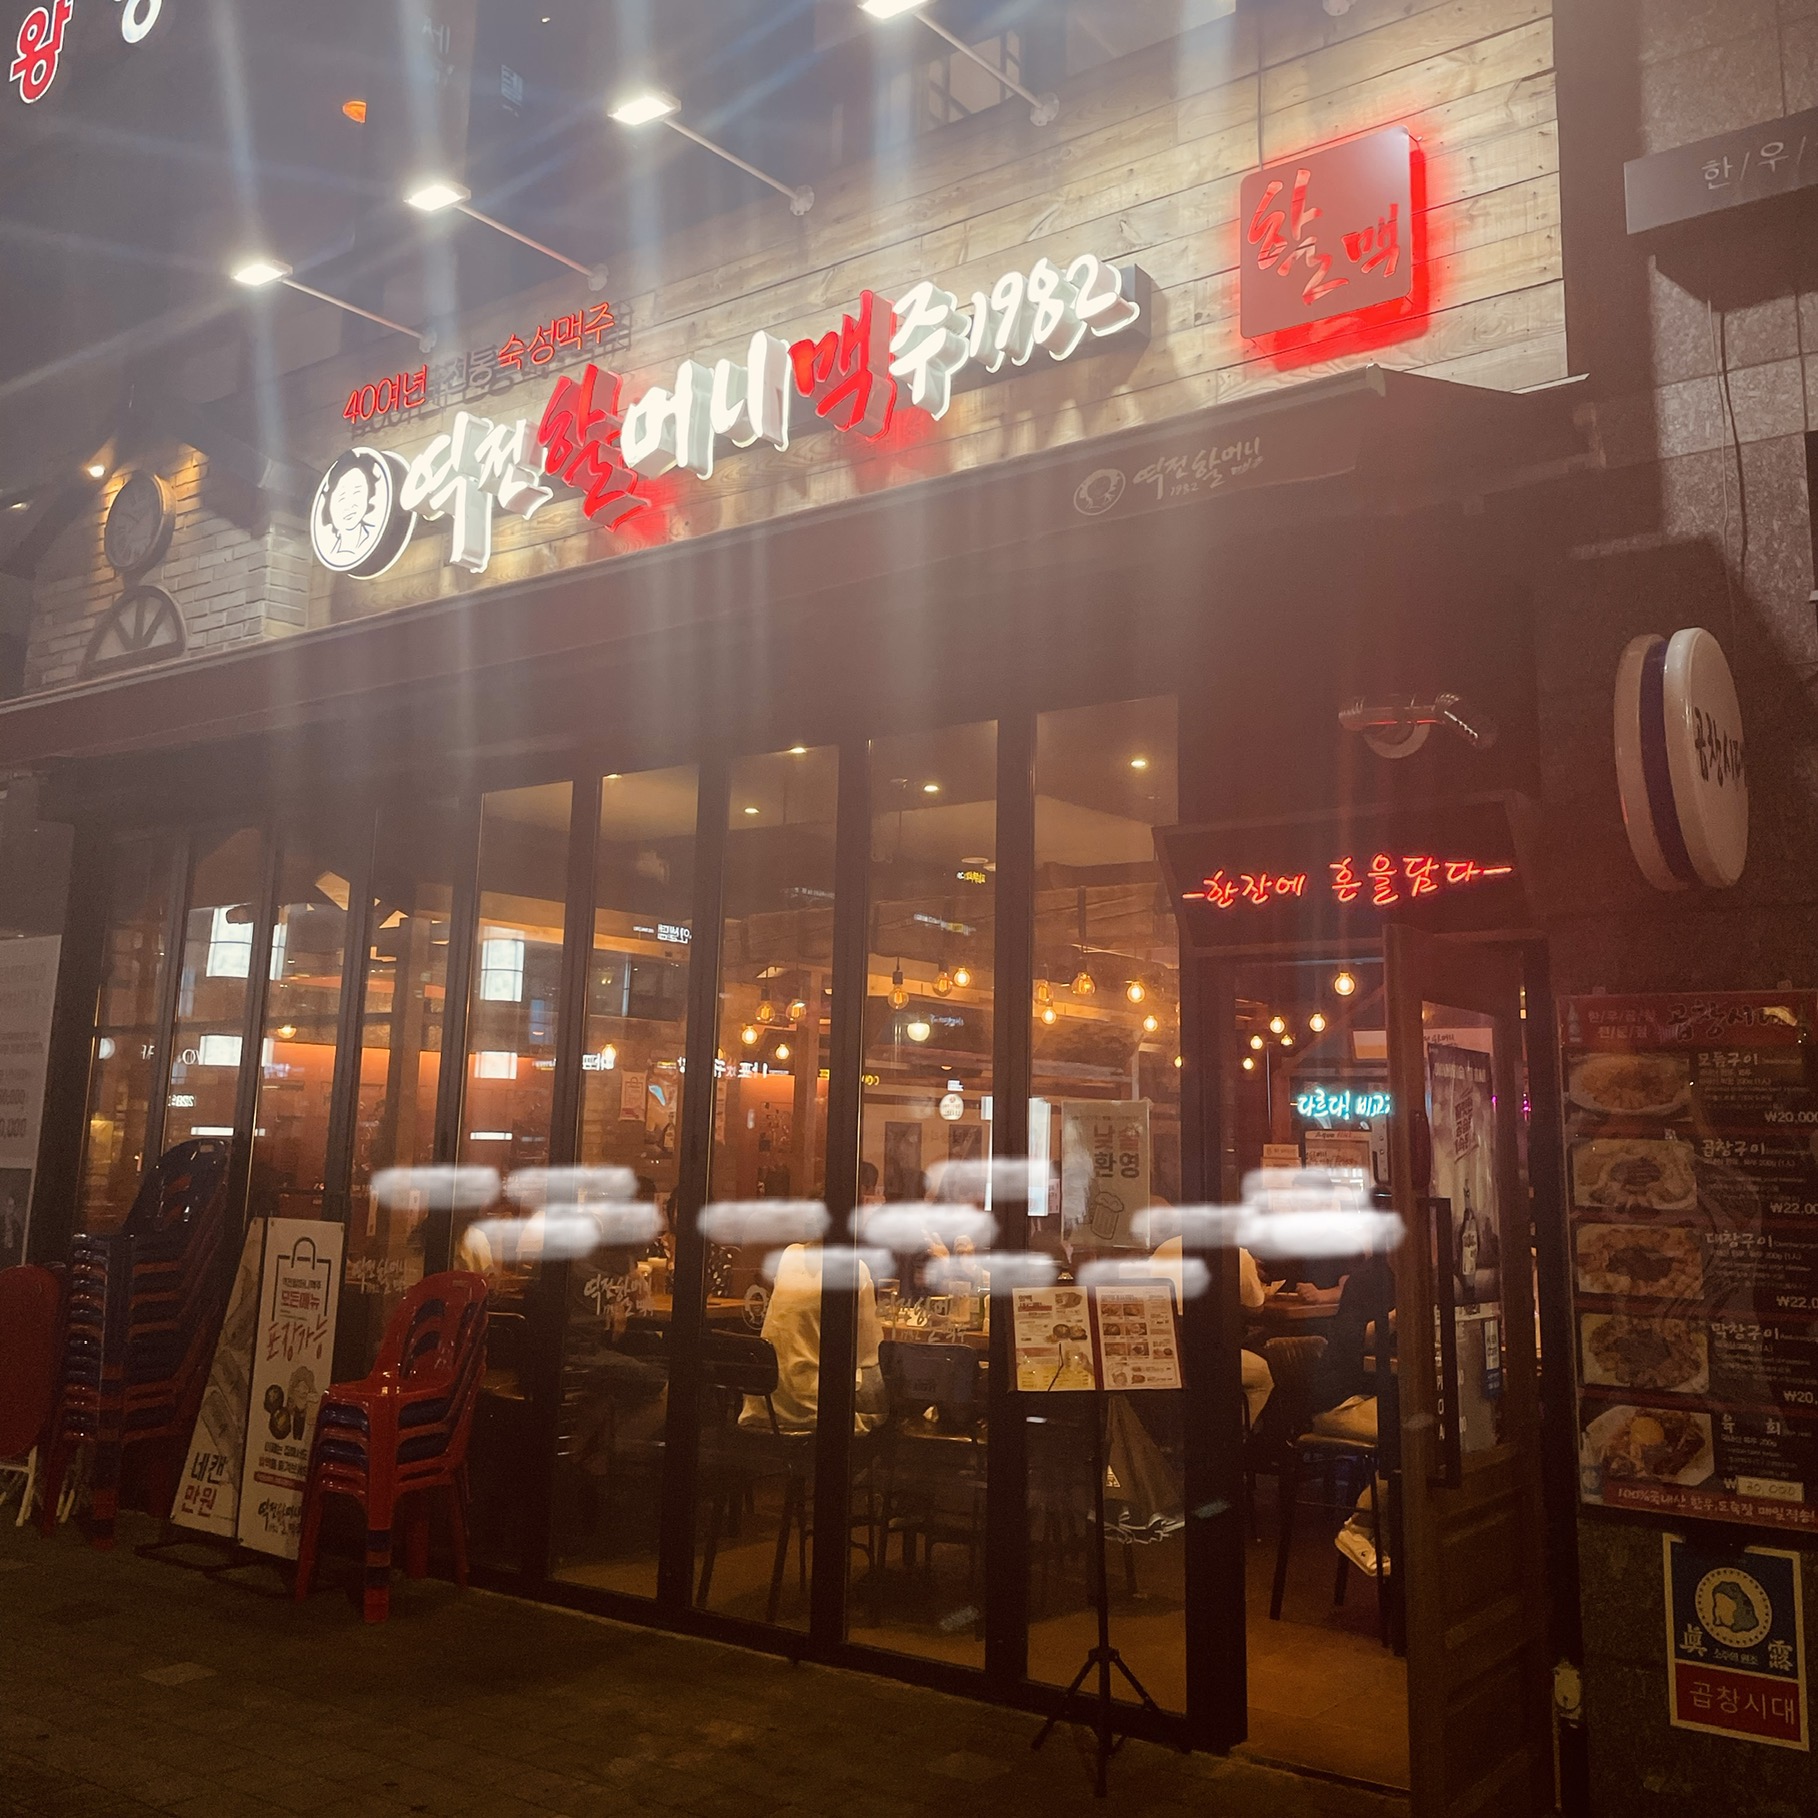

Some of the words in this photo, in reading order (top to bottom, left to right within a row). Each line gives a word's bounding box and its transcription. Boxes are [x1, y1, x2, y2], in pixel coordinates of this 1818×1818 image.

[497, 301, 616, 370] 숙성맥주
[1701, 1138, 1766, 1158] 곱창구이
[1704, 1229, 1773, 1249] 대창구이
[266, 1313, 328, 1362] 포장가능
[1710, 1321, 1779, 1341] 막창구이
[189, 1451, 228, 1484] 네캔
[180, 1484, 217, 1518] 만원
[1689, 1681, 1795, 1725] 곱창시대
